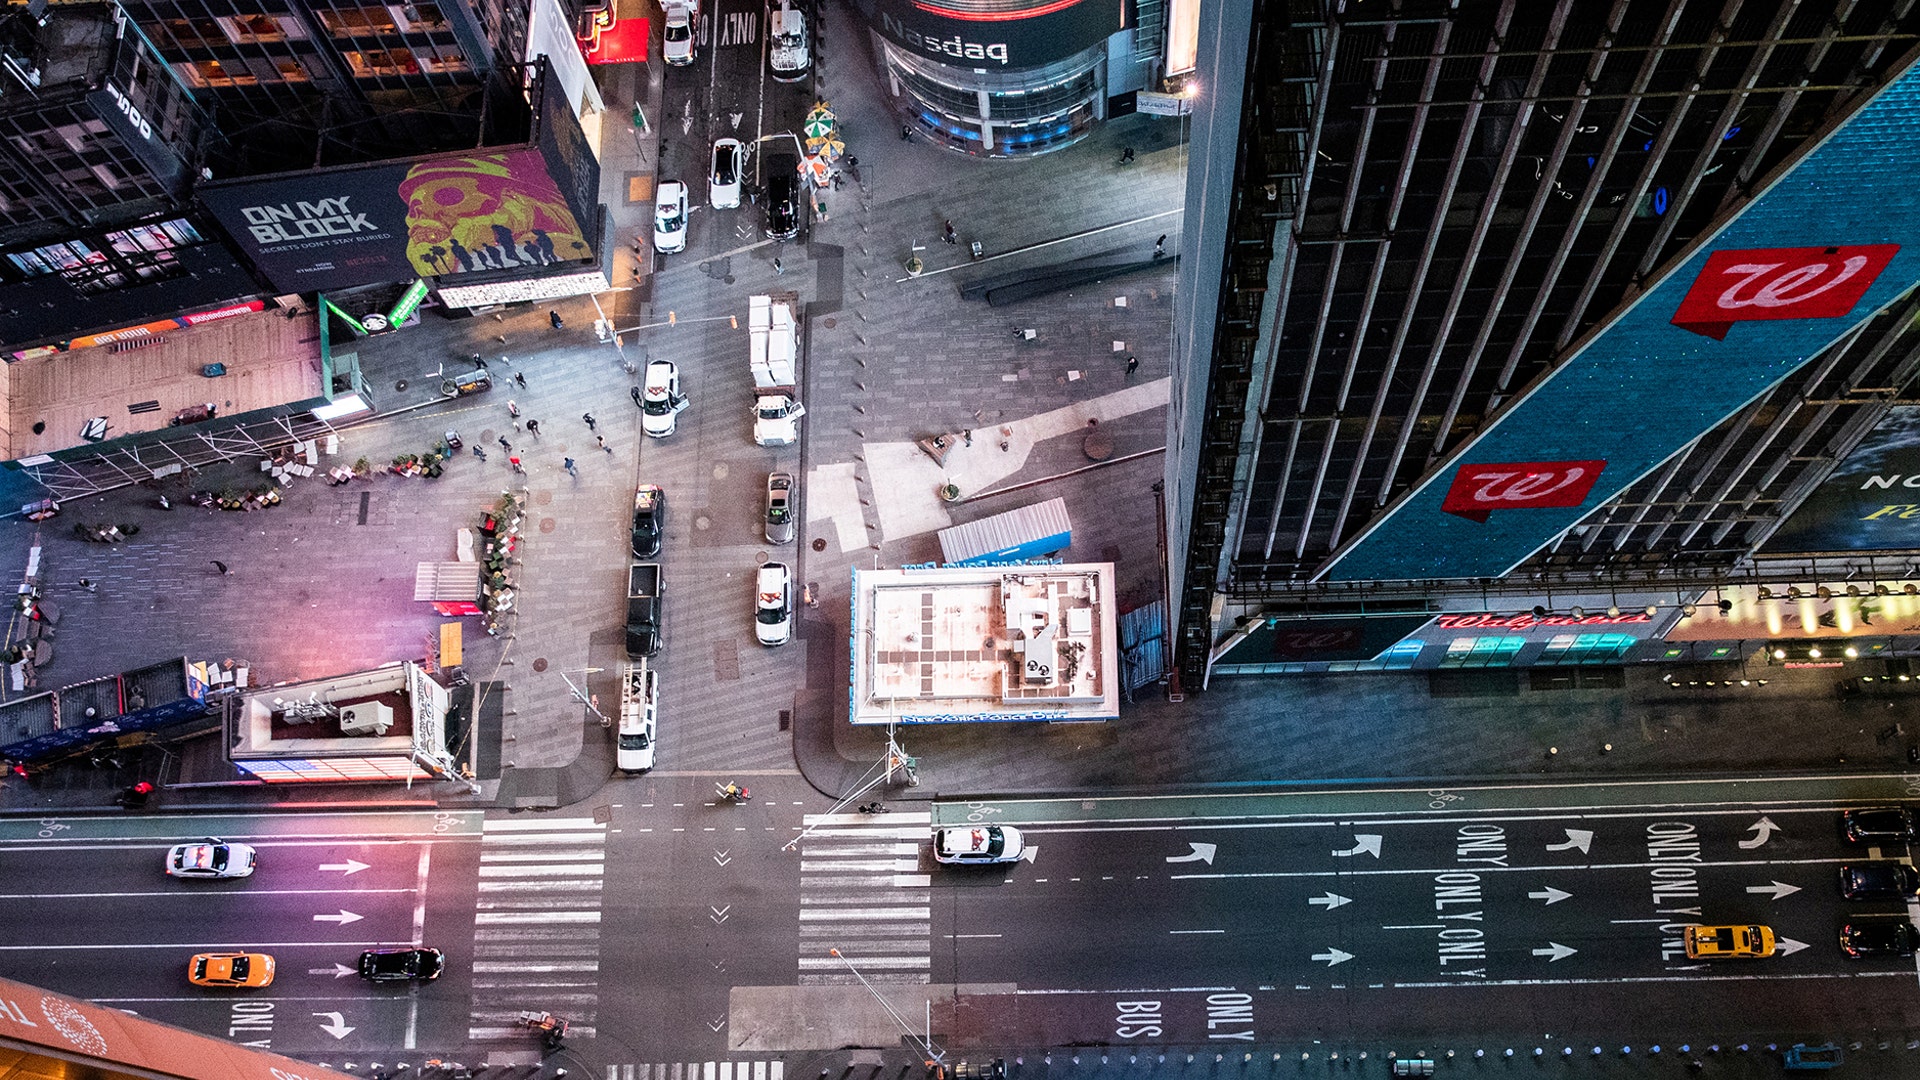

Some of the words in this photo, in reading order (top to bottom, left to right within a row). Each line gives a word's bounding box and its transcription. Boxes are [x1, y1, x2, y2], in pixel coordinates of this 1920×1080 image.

[721, 12, 757, 46] ONLY
[882, 12, 1008, 65] Nasdaq
[106, 82, 151, 140] 1500
[241, 203, 298, 225] ON
[296, 195, 351, 219] MY
[248, 212, 379, 244] BLOCK
[1438, 613, 1652, 631] Walgreens
[1457, 825, 1509, 867] ONLY
[1647, 822, 1702, 862] ONLY
[1435, 873, 1483, 921] ONLY
[1651, 867, 1702, 916] ONLY
[1438, 929, 1487, 978] ONLY
[229, 1002, 274, 1049] ONLY
[1116, 1001, 1163, 1039] BUS
[1206, 993, 1255, 1041] ONLY
